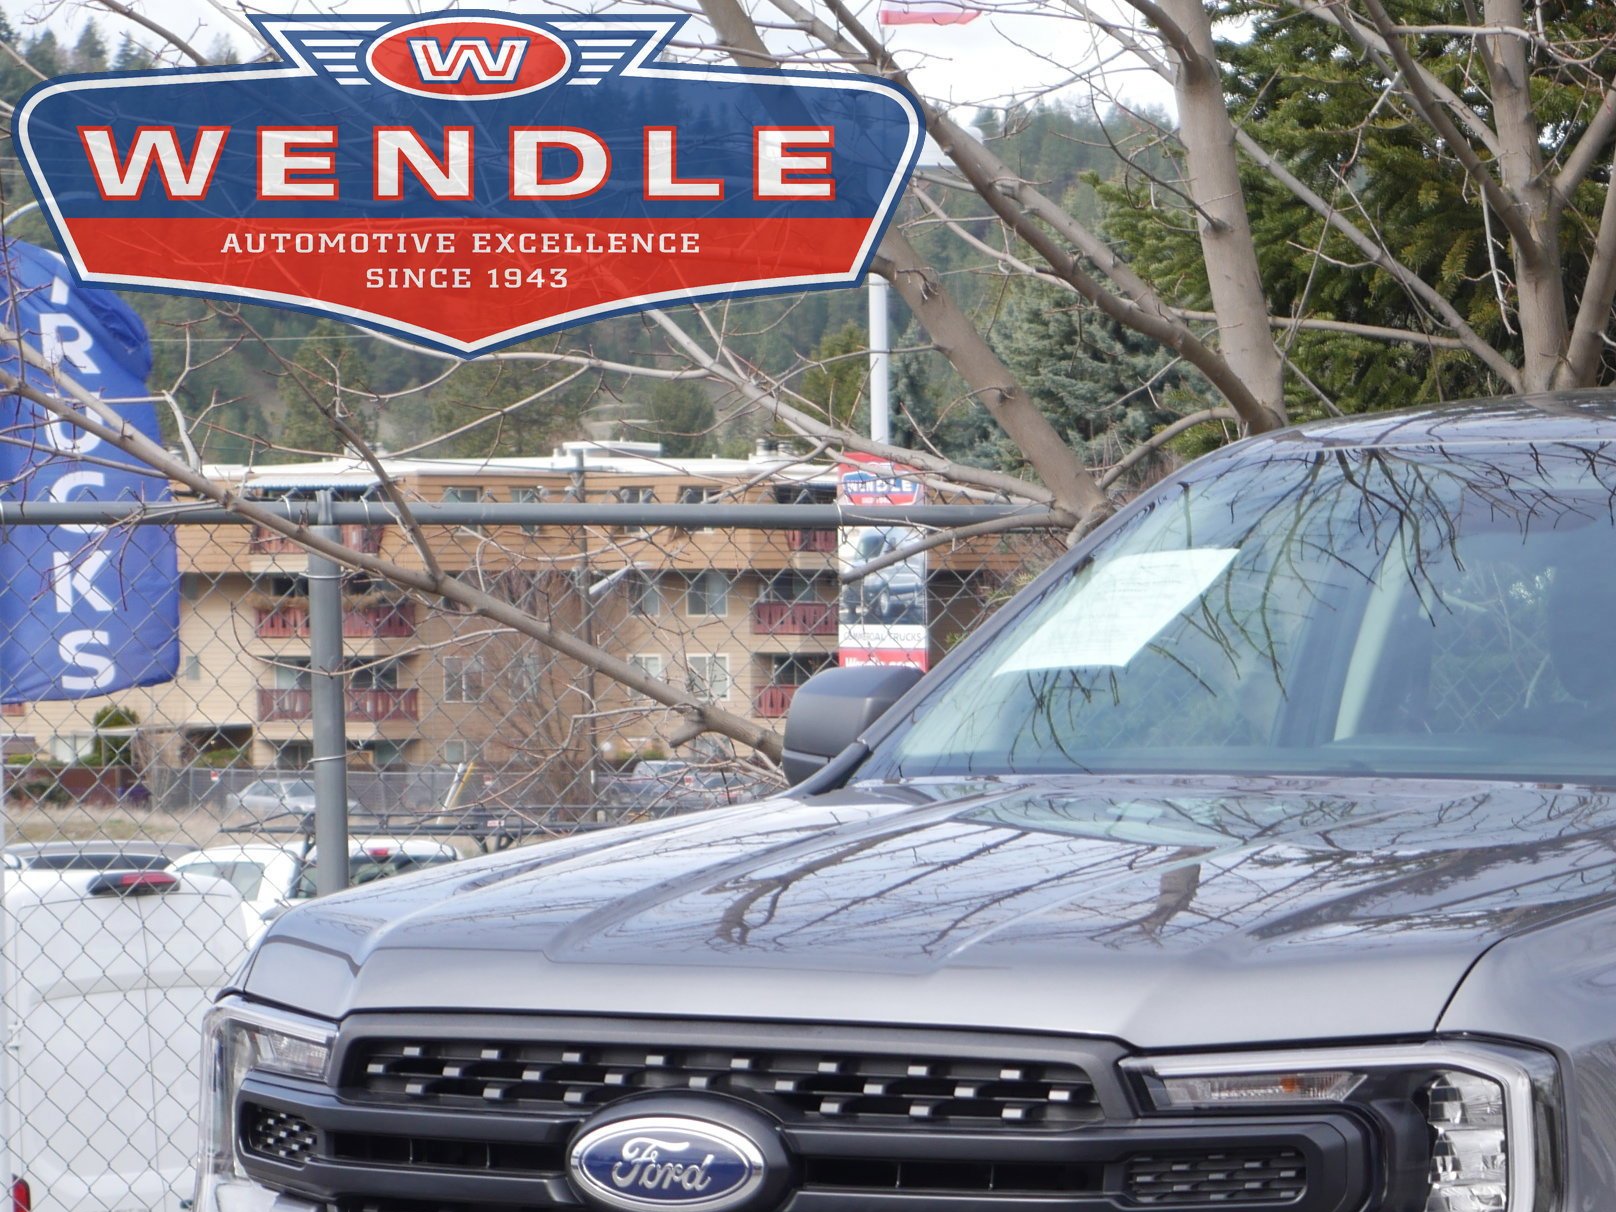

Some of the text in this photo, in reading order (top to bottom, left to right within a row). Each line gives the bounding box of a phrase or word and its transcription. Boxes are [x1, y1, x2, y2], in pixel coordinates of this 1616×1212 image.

[846, 478, 913, 494] WENDLE
[888, 632, 922, 642] TRUCKS
[611, 1136, 715, 1191] Ford
